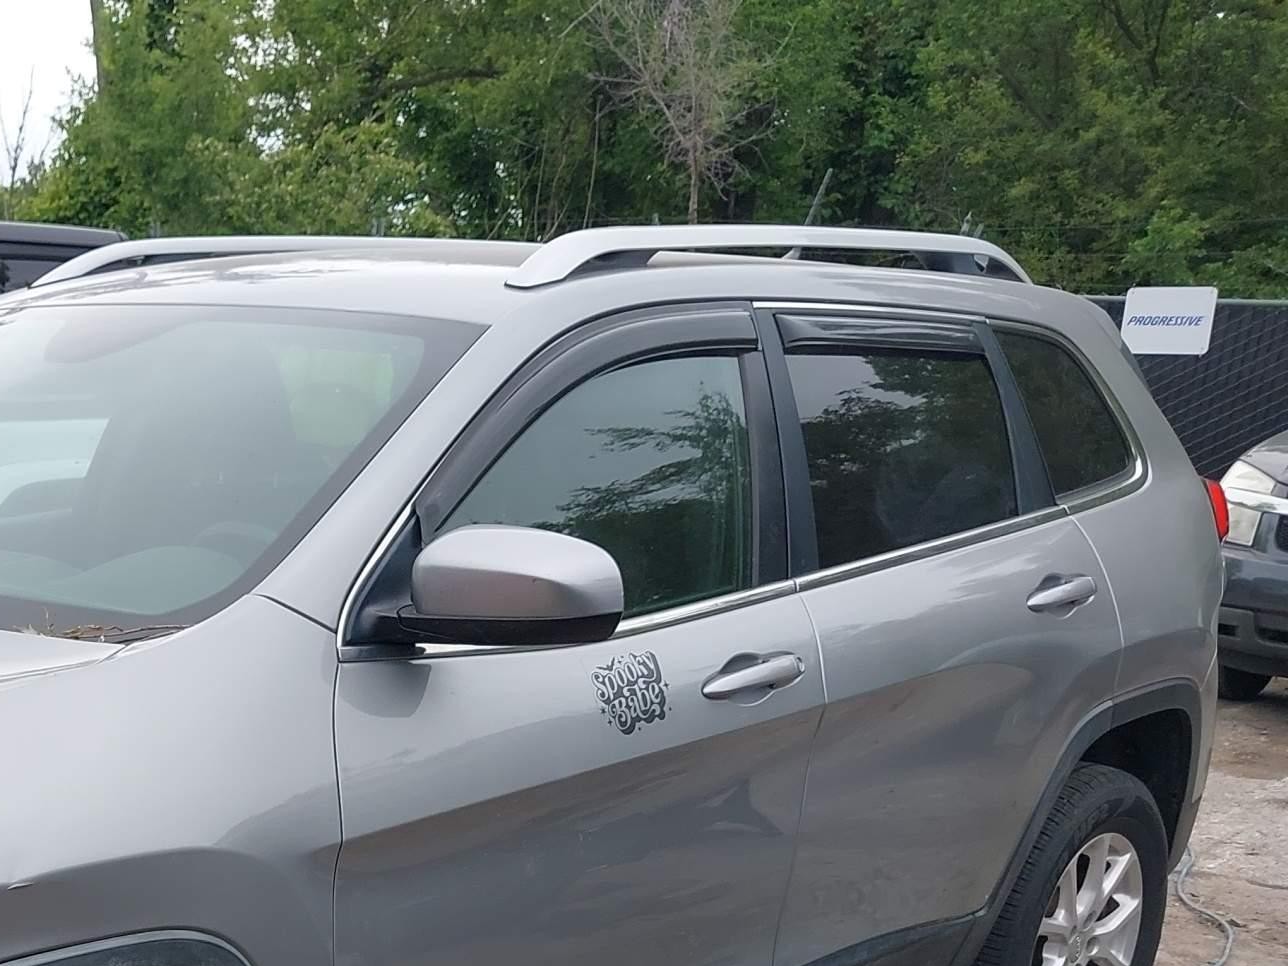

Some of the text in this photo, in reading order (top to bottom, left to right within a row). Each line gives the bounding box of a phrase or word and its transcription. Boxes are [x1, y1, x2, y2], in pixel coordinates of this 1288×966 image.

[1127, 315, 1204, 327] PROGRESSIVE
[592, 651, 659, 701] Spooky
[608, 682, 663, 731] Babe
